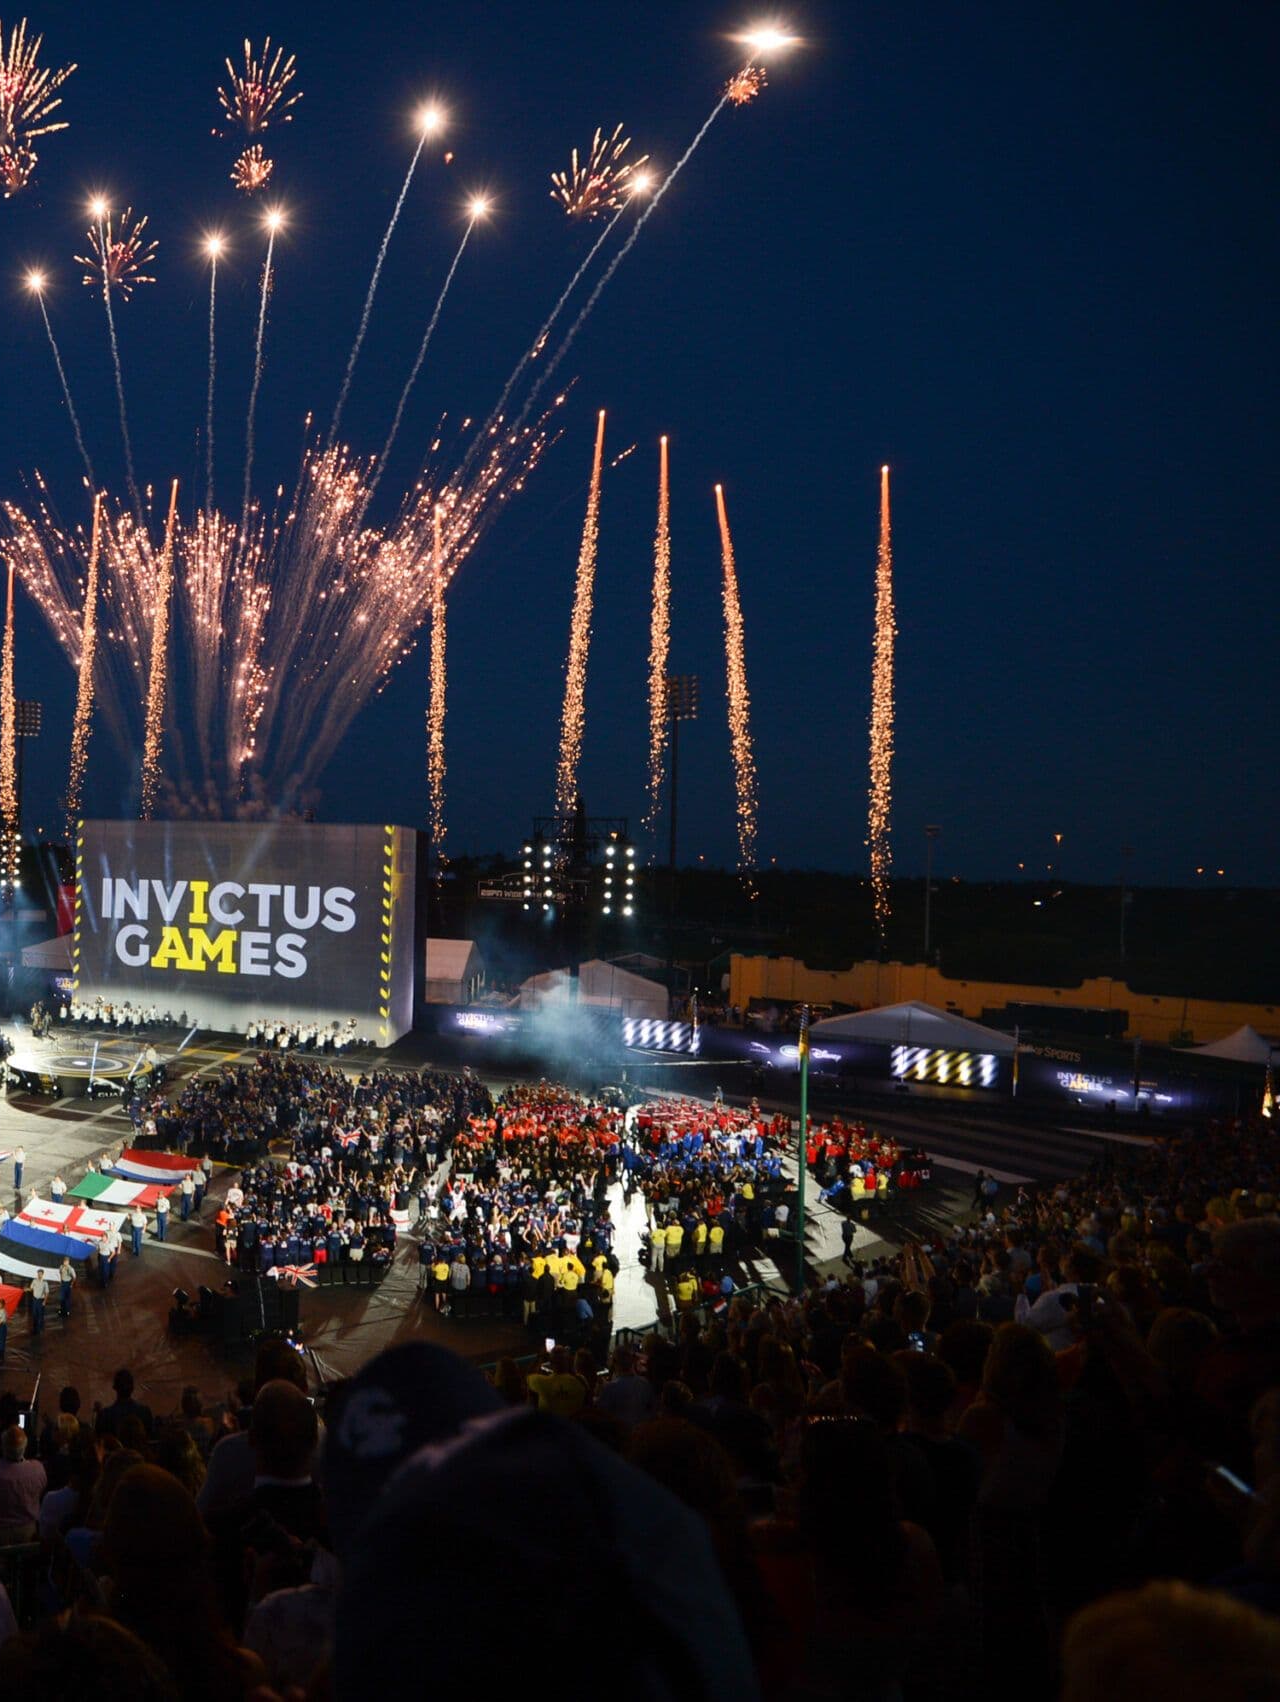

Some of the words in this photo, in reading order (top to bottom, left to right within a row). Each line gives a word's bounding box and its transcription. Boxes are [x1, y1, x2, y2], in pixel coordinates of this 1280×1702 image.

[101, 877, 356, 933] INVICTUS
[115, 923, 308, 979] GAMES
[1056, 1071, 1113, 1085] INVICTUS
